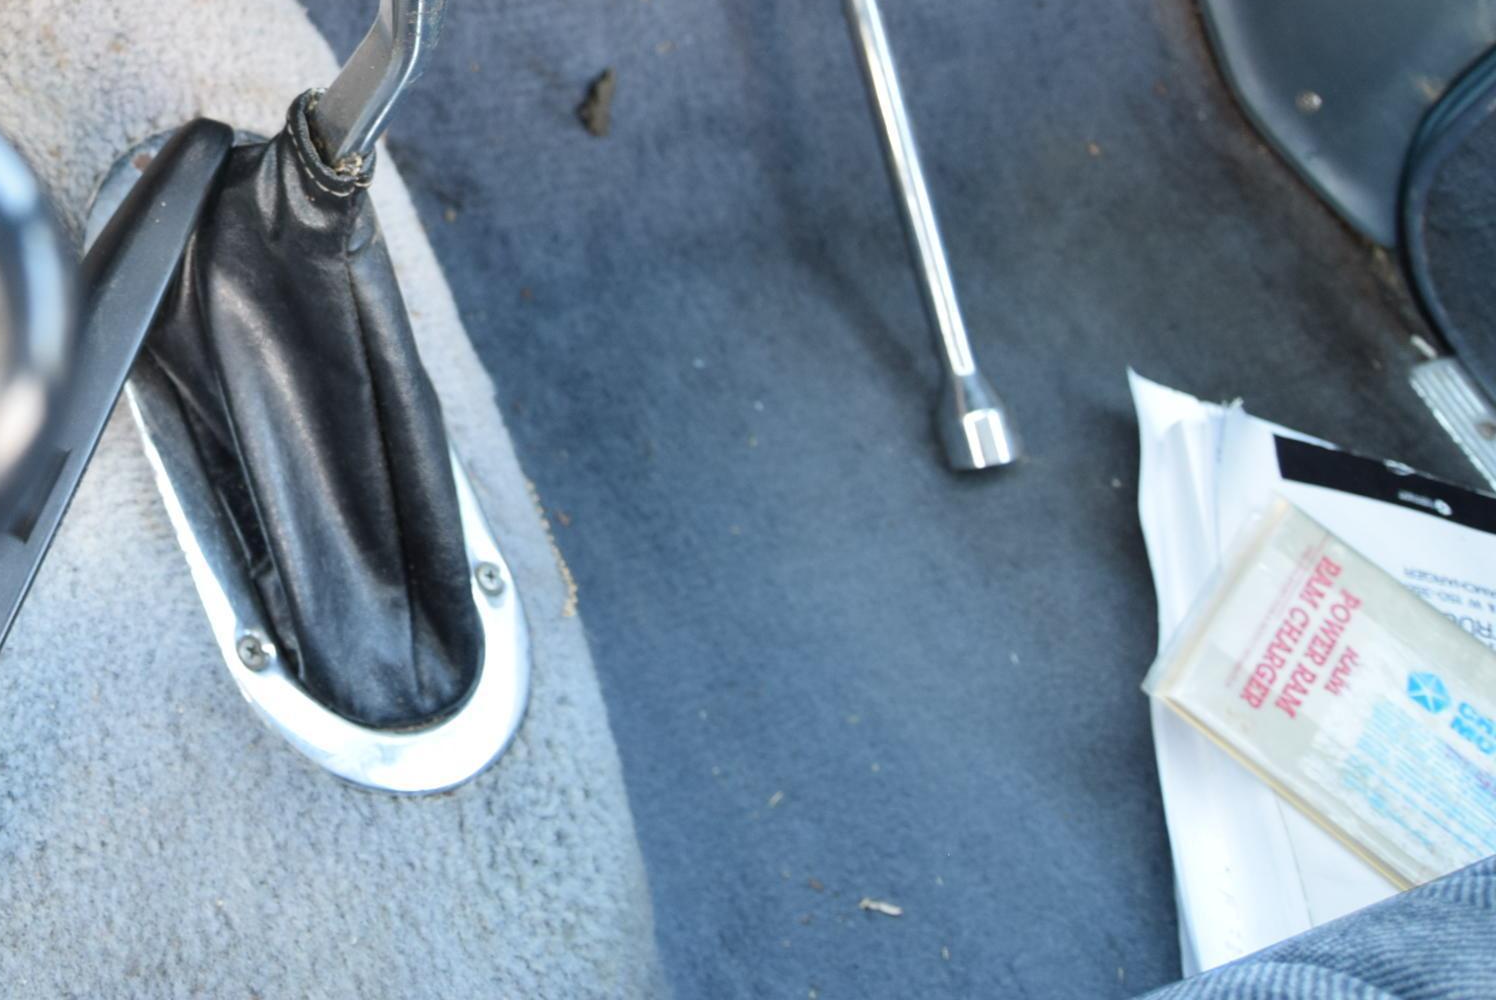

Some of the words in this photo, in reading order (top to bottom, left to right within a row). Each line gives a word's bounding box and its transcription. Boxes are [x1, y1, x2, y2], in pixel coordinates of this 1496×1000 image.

[1299, 556, 1343, 610] RAM
[1240, 606, 1311, 709] CHARGER
[1304, 588, 1363, 667] POWER
[1273, 662, 1317, 719] RAM
